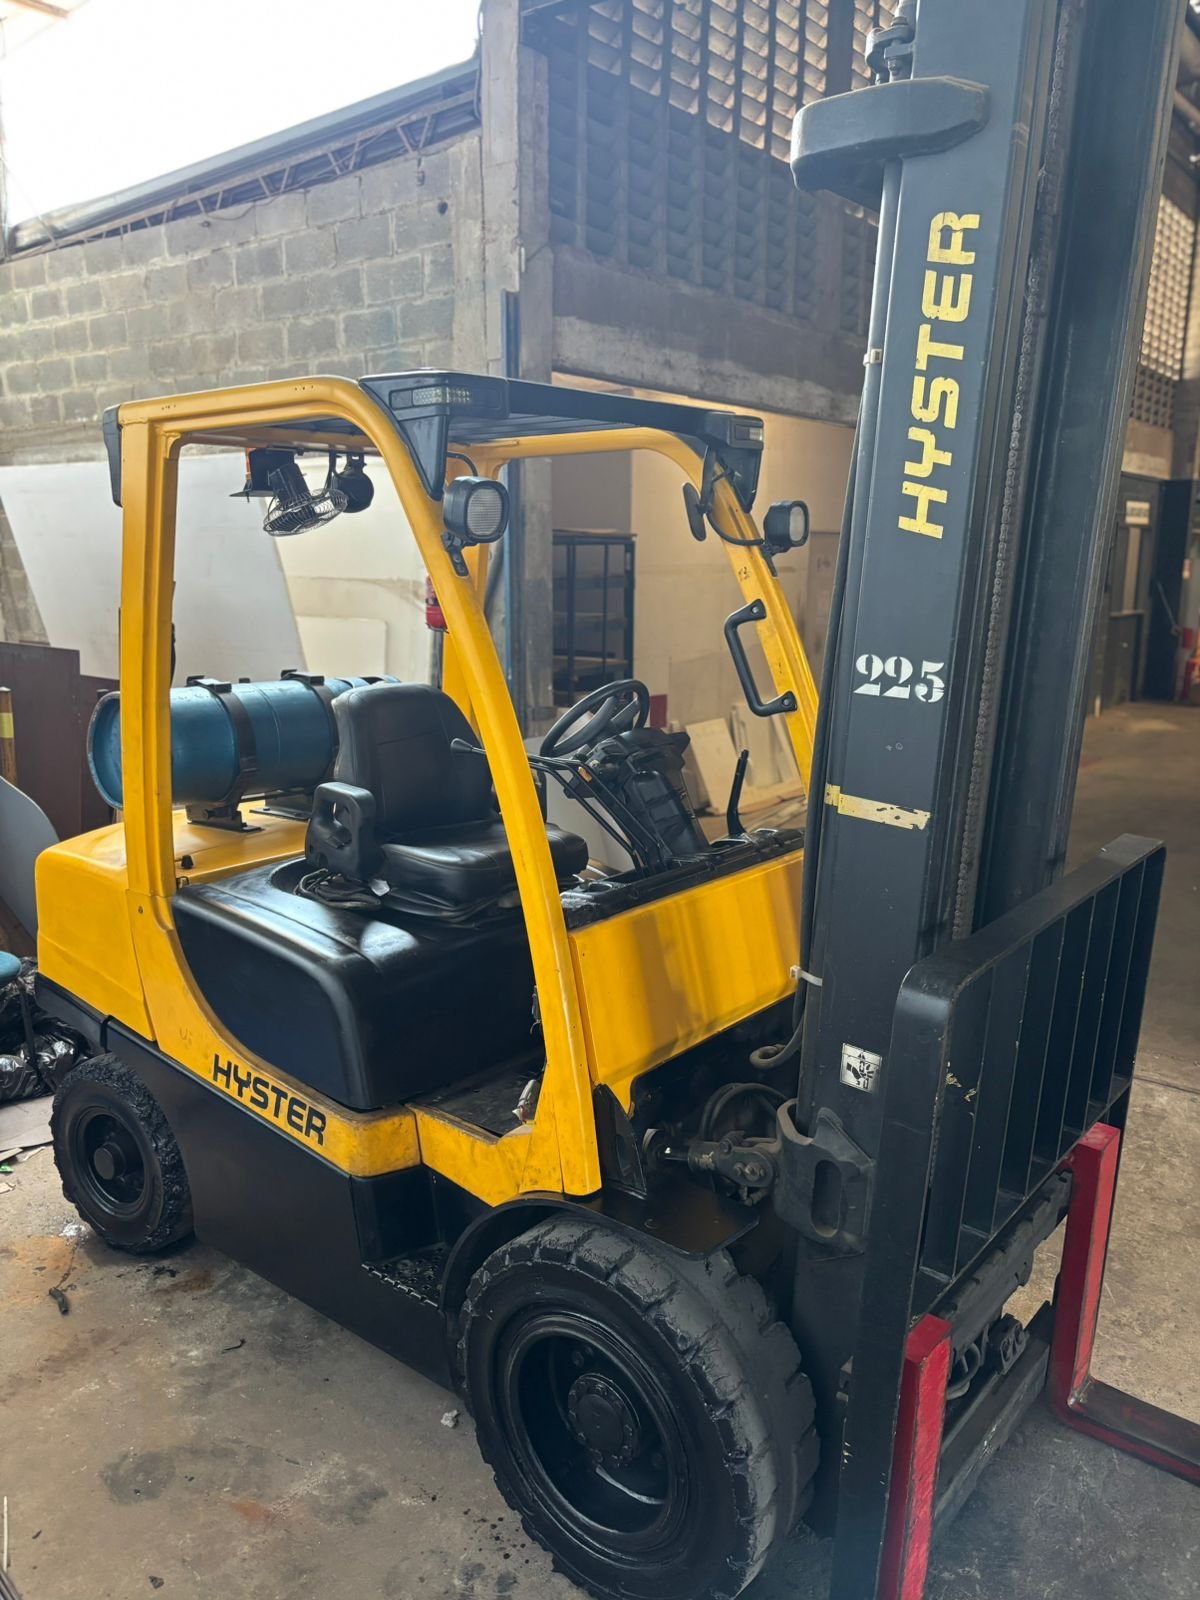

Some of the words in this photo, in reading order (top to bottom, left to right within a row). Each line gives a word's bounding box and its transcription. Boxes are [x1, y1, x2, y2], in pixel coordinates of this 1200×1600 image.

[898, 211, 980, 539] HYSTER
[853, 653, 945, 703] 225
[213, 1053, 327, 1146] HYSTER
